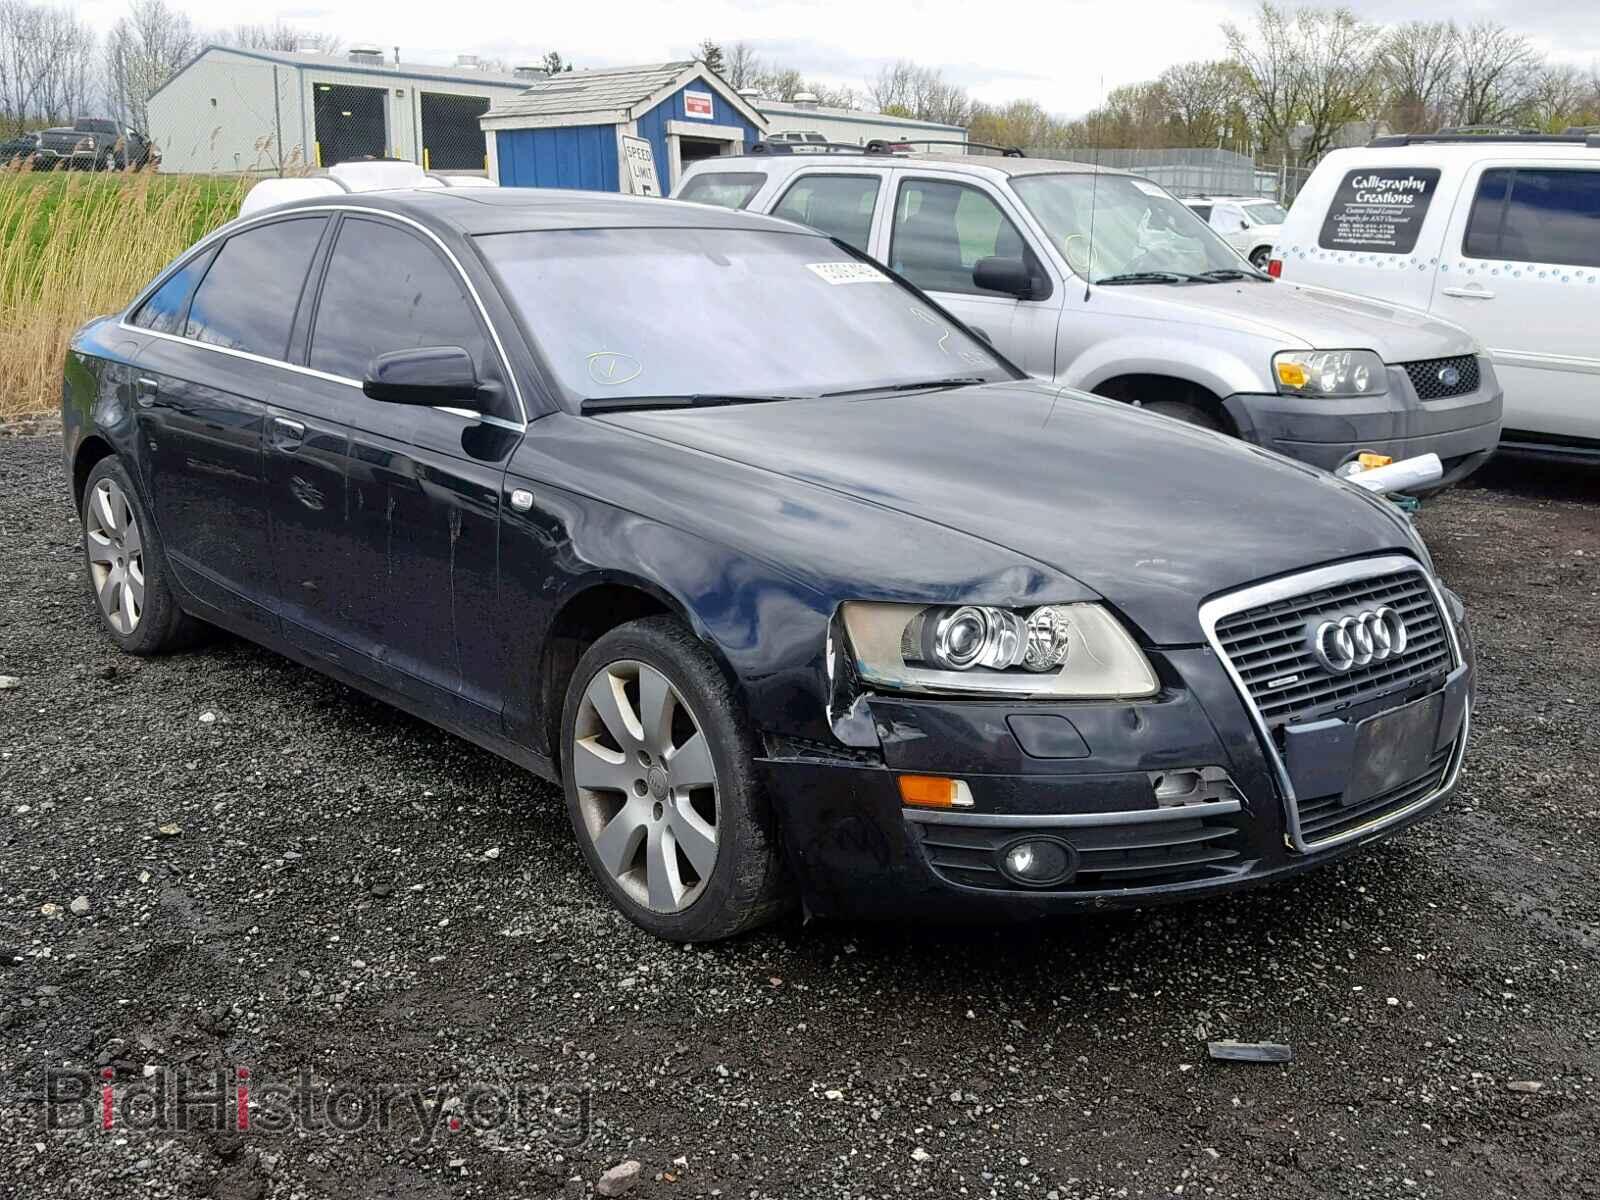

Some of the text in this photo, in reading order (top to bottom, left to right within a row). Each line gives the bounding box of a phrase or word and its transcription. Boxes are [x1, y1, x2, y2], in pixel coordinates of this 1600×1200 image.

[626, 145, 651, 162] SPEED
[633, 165, 652, 179] LIMIT
[1352, 176, 1426, 192] Calligraphy
[1356, 190, 1414, 204] Creations
